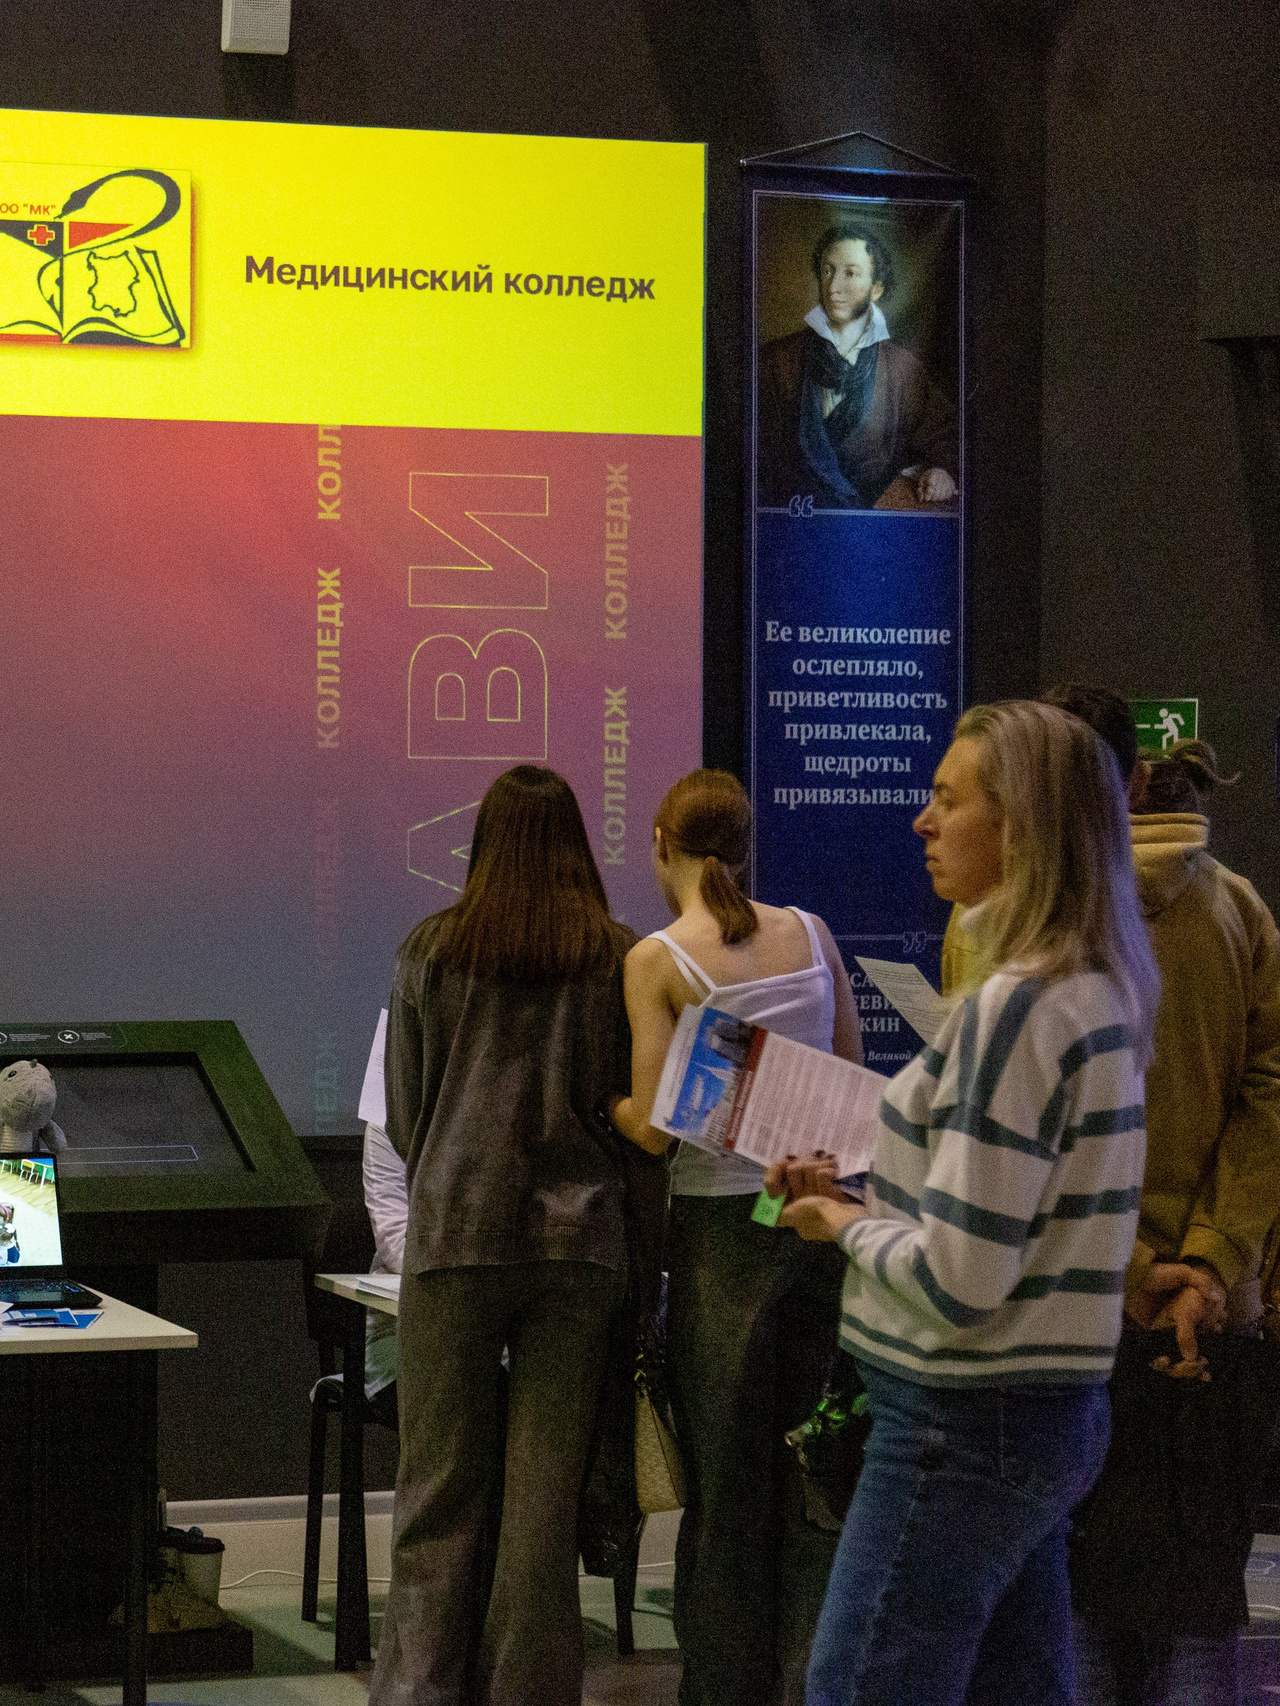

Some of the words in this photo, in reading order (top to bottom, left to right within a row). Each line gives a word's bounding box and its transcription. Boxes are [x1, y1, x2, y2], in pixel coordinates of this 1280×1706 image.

[0, 203, 19, 214] ОО
[245, 255, 493, 294] Медицинский
[505, 268, 656, 303] колледж
[604, 462, 631, 640] КОЛЛЕДЖ
[766, 621, 792, 642] Ее
[798, 627, 951, 645] великолепие
[317, 567, 344, 749] КОЛЛЕДЖ
[792, 659, 924, 680] ослепляло,
[768, 690, 947, 713] приветливость
[784, 723, 931, 745] привлекала,
[604, 686, 630, 866] КОЛЛЕДЖ
[805, 753, 911, 778] щедроты
